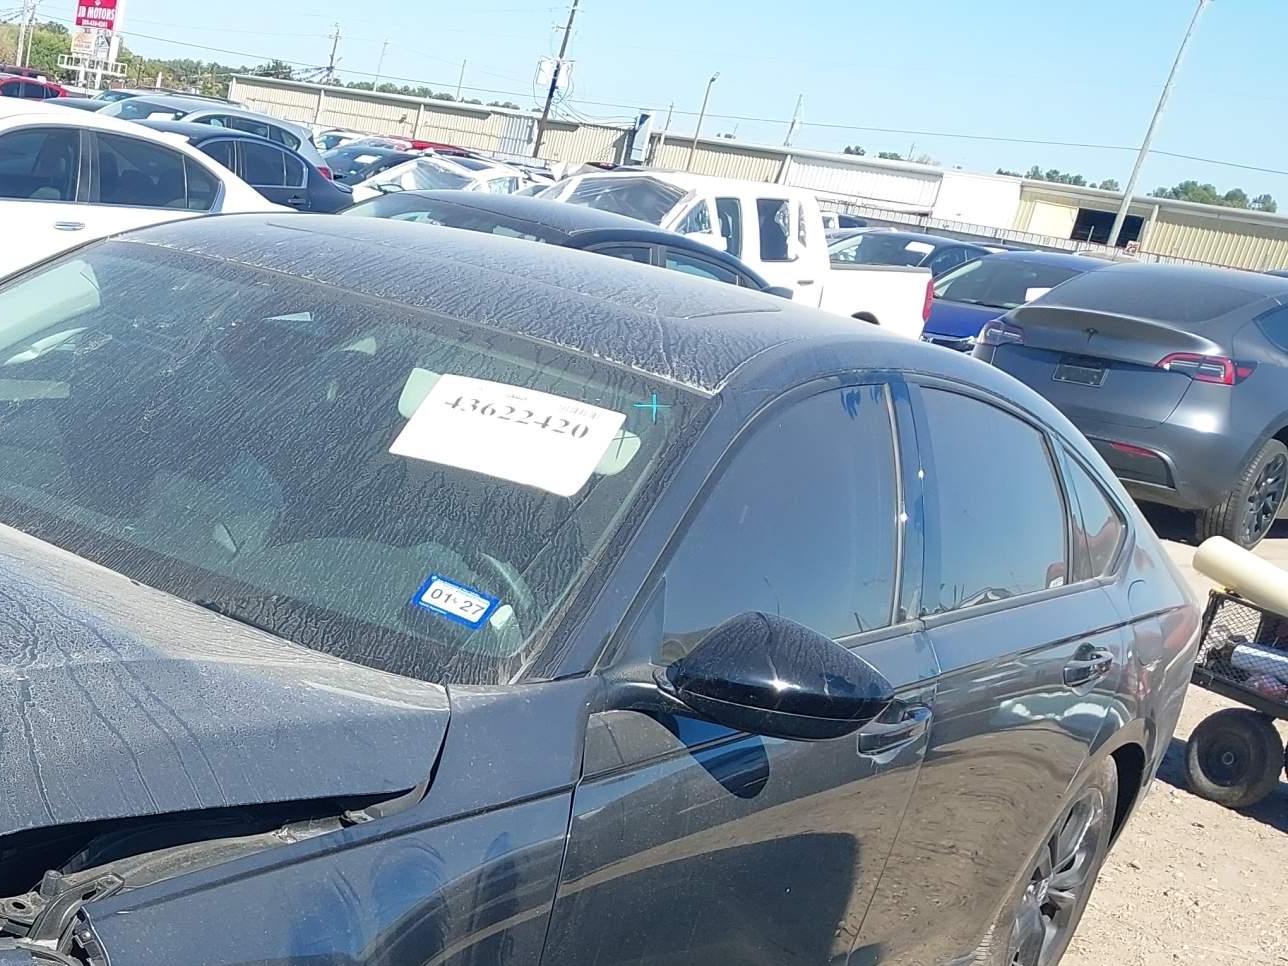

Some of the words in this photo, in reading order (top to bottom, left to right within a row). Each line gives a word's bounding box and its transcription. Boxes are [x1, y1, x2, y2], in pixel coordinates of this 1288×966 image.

[78, 5, 87, 18] JB
[86, 6, 115, 20] MOTORS
[444, 396, 589, 439] 43622420
